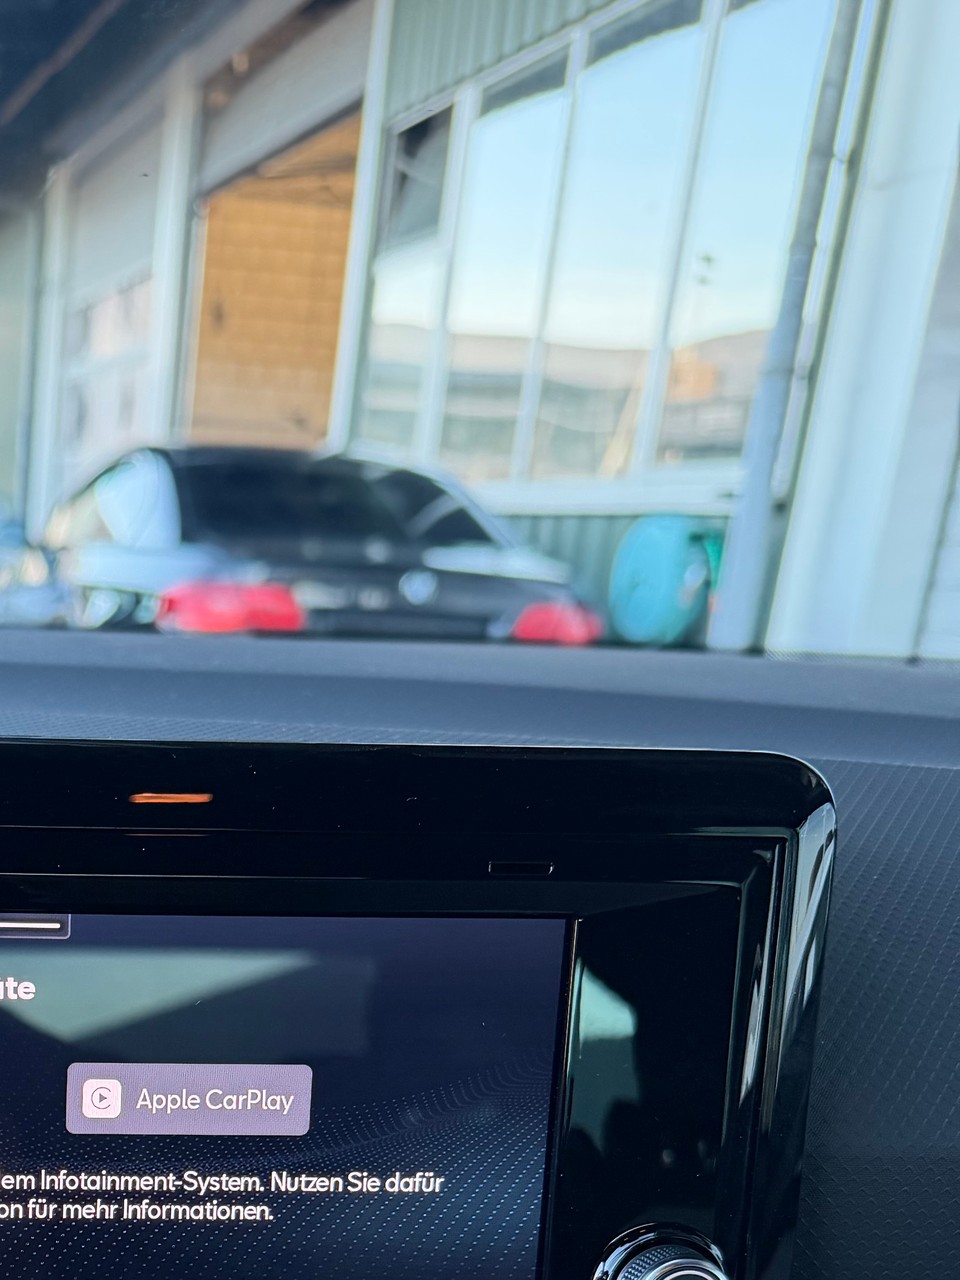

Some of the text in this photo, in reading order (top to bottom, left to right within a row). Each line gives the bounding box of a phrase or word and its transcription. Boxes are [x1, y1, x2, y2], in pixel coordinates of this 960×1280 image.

[136, 1089, 294, 1114] Apple CarPlay
[40, 1171, 264, 1195] Infotainment-System.
[271, 1172, 342, 1192] Nutzen
[347, 1173, 381, 1193] Sie
[385, 1173, 444, 1193] dafür
[27, 1199, 58, 1220] für
[63, 1201, 117, 1220] mehr
[122, 1201, 273, 1221] Informationen.
